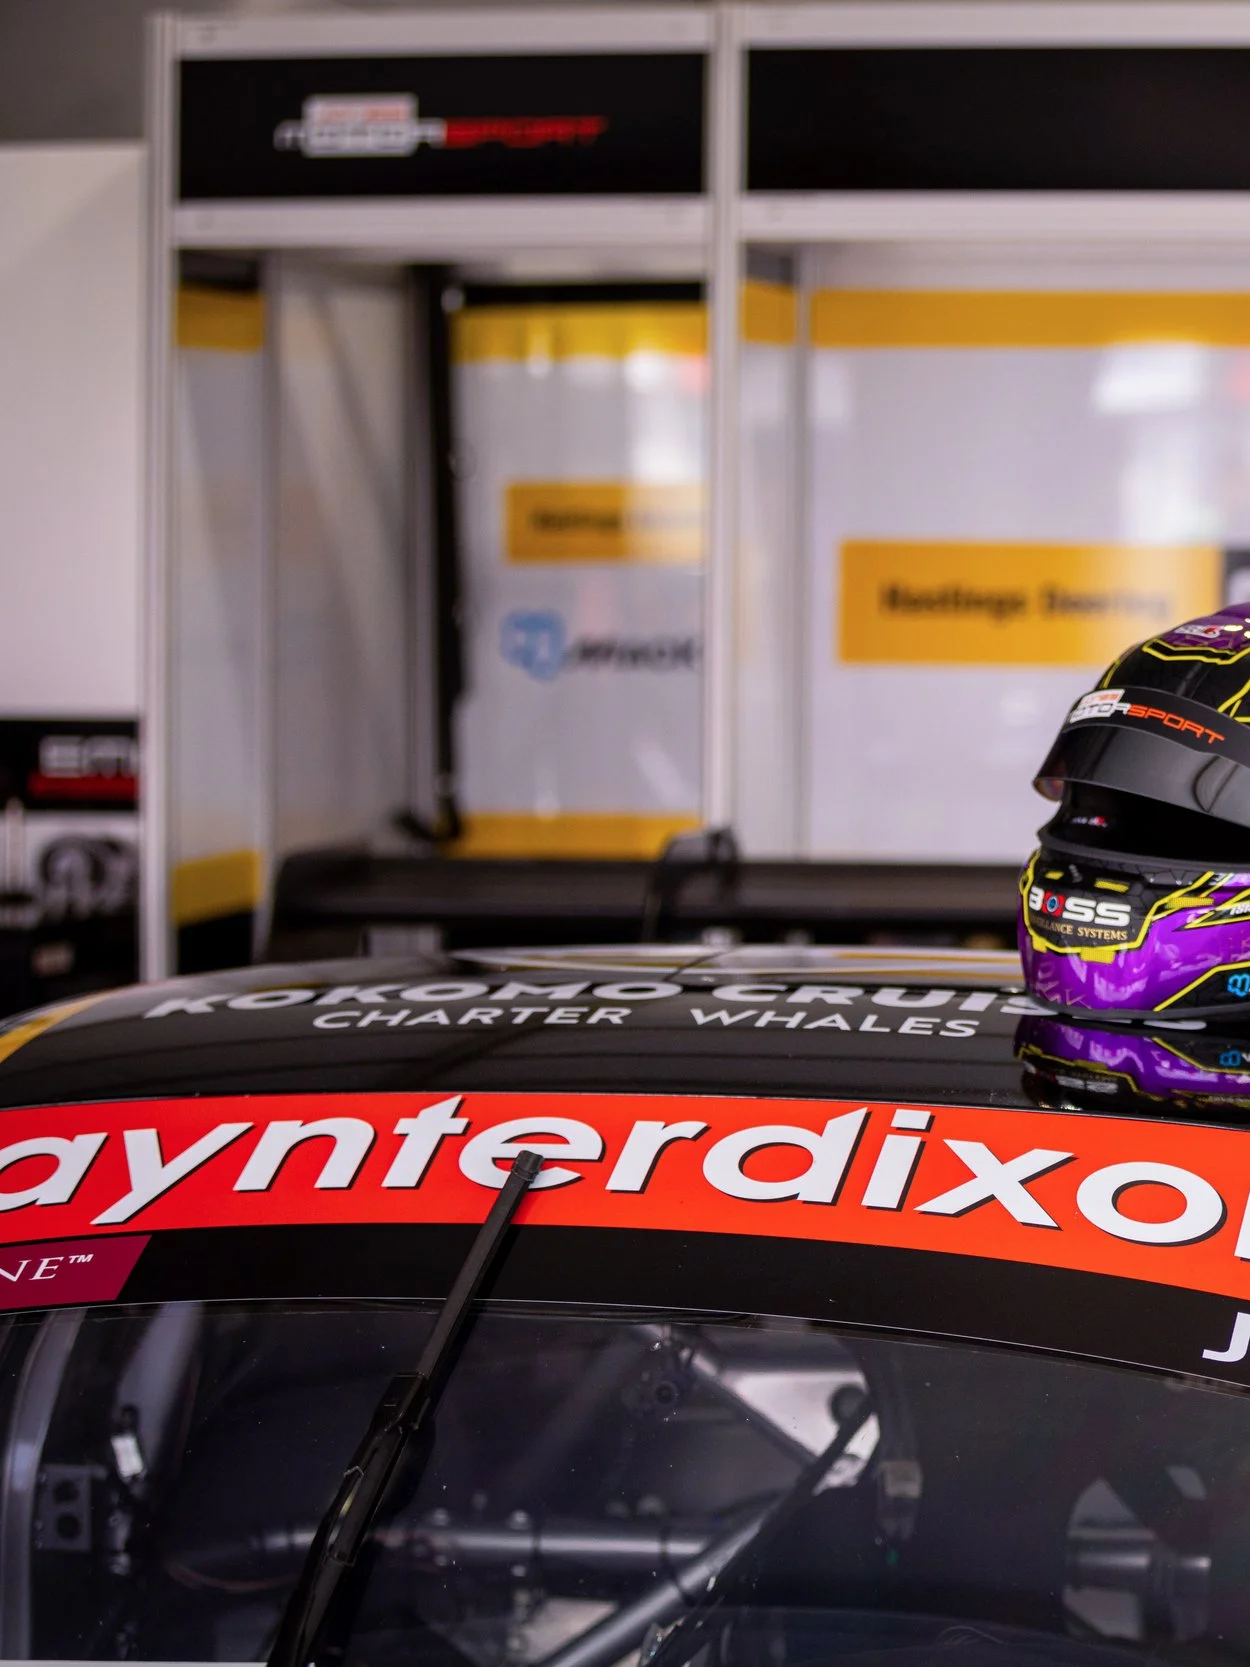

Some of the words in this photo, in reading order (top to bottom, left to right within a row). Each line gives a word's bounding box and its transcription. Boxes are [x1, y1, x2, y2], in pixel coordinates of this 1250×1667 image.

[1077, 926, 1129, 941] SYSTEMS
[143, 981, 683, 1019] KOKOMO
[312, 1006, 633, 1029] CHARTER
[690, 1007, 981, 1038] WHALES
